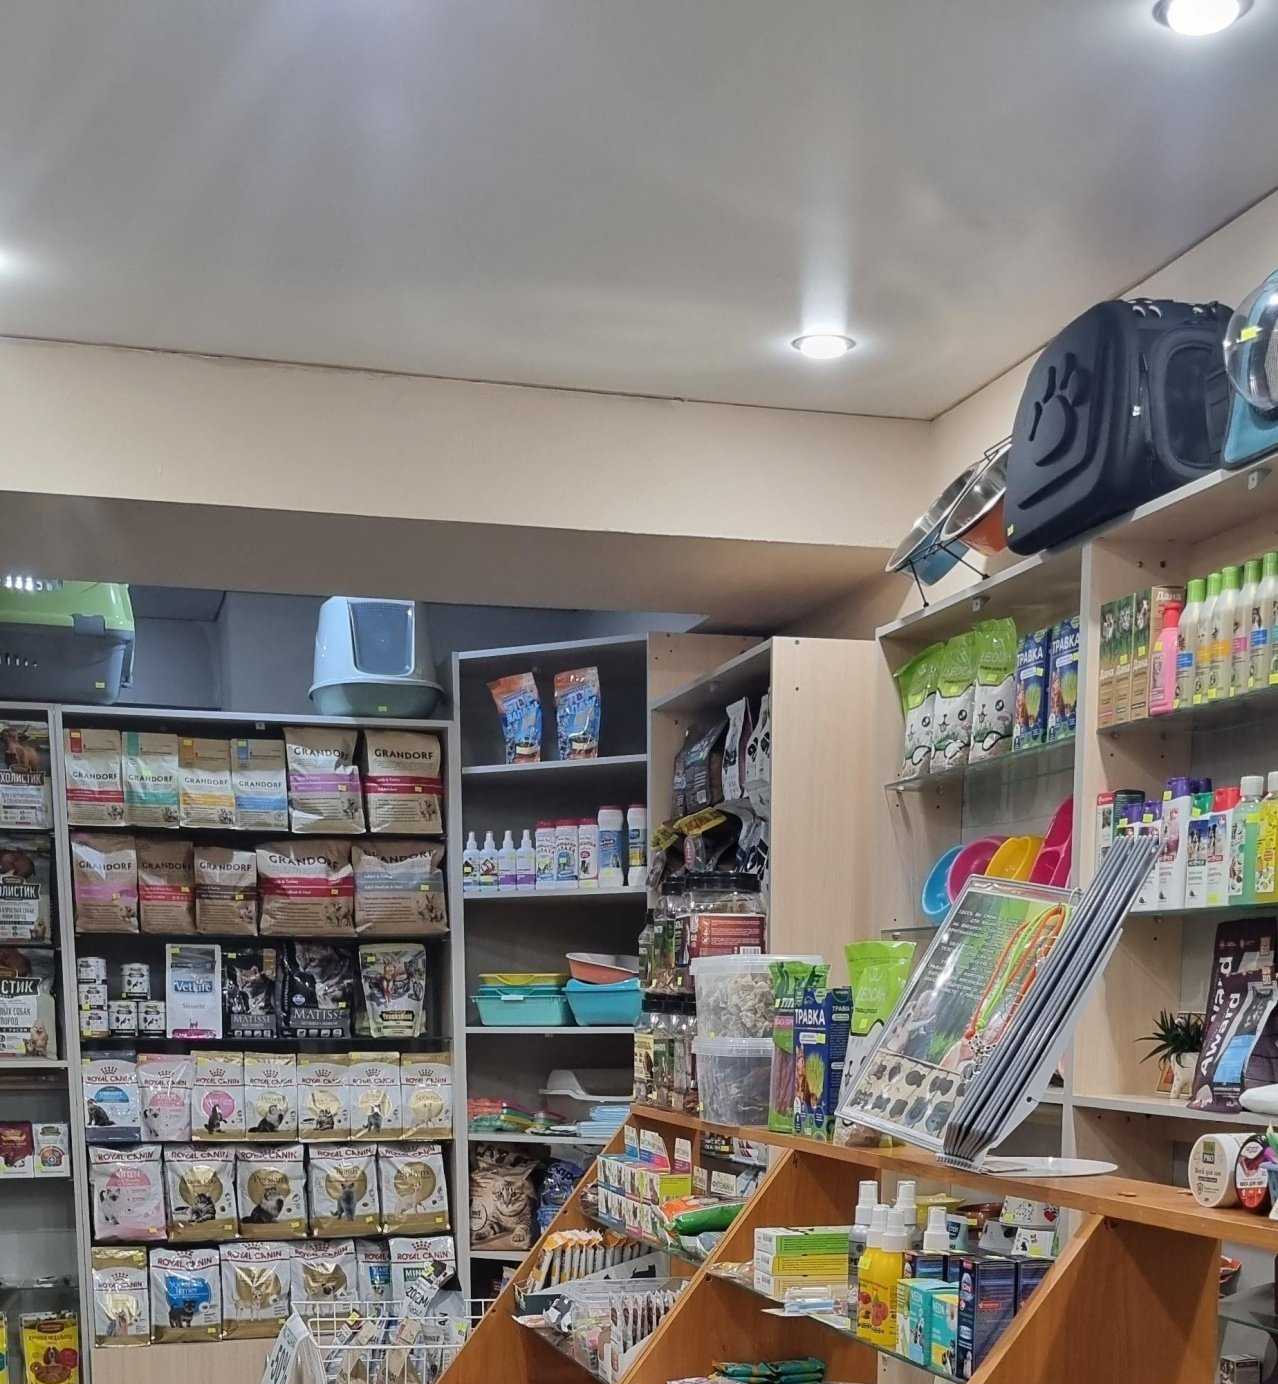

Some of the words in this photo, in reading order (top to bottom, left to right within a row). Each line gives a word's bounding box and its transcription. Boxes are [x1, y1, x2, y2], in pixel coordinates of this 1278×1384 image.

[1052, 633, 1080, 652] ТРАВКА
[1017, 646, 1043, 664] ТРАВКА
[374, 748, 433, 760] GRANDORF
[0, 773, 41, 785] ХОЛИСТИК
[72, 771, 118, 780] GRANDORF
[128, 774, 173, 782] GRANDORF
[184, 777, 229, 785] GRANDORF
[238, 780, 282, 789] GRANDORF
[142, 861, 193, 871] GRANDORF
[199, 861, 252, 872] GRANDORF
[0, 886, 36, 897] ЛИСТИК
[795, 1008, 826, 1025] ТРАВКА
[1201, 993, 1240, 1077] Award
[254, 1250, 282, 1259] CANIN
[422, 1251, 448, 1259] CANIN
[157, 1256, 181, 1267] ROYAL
